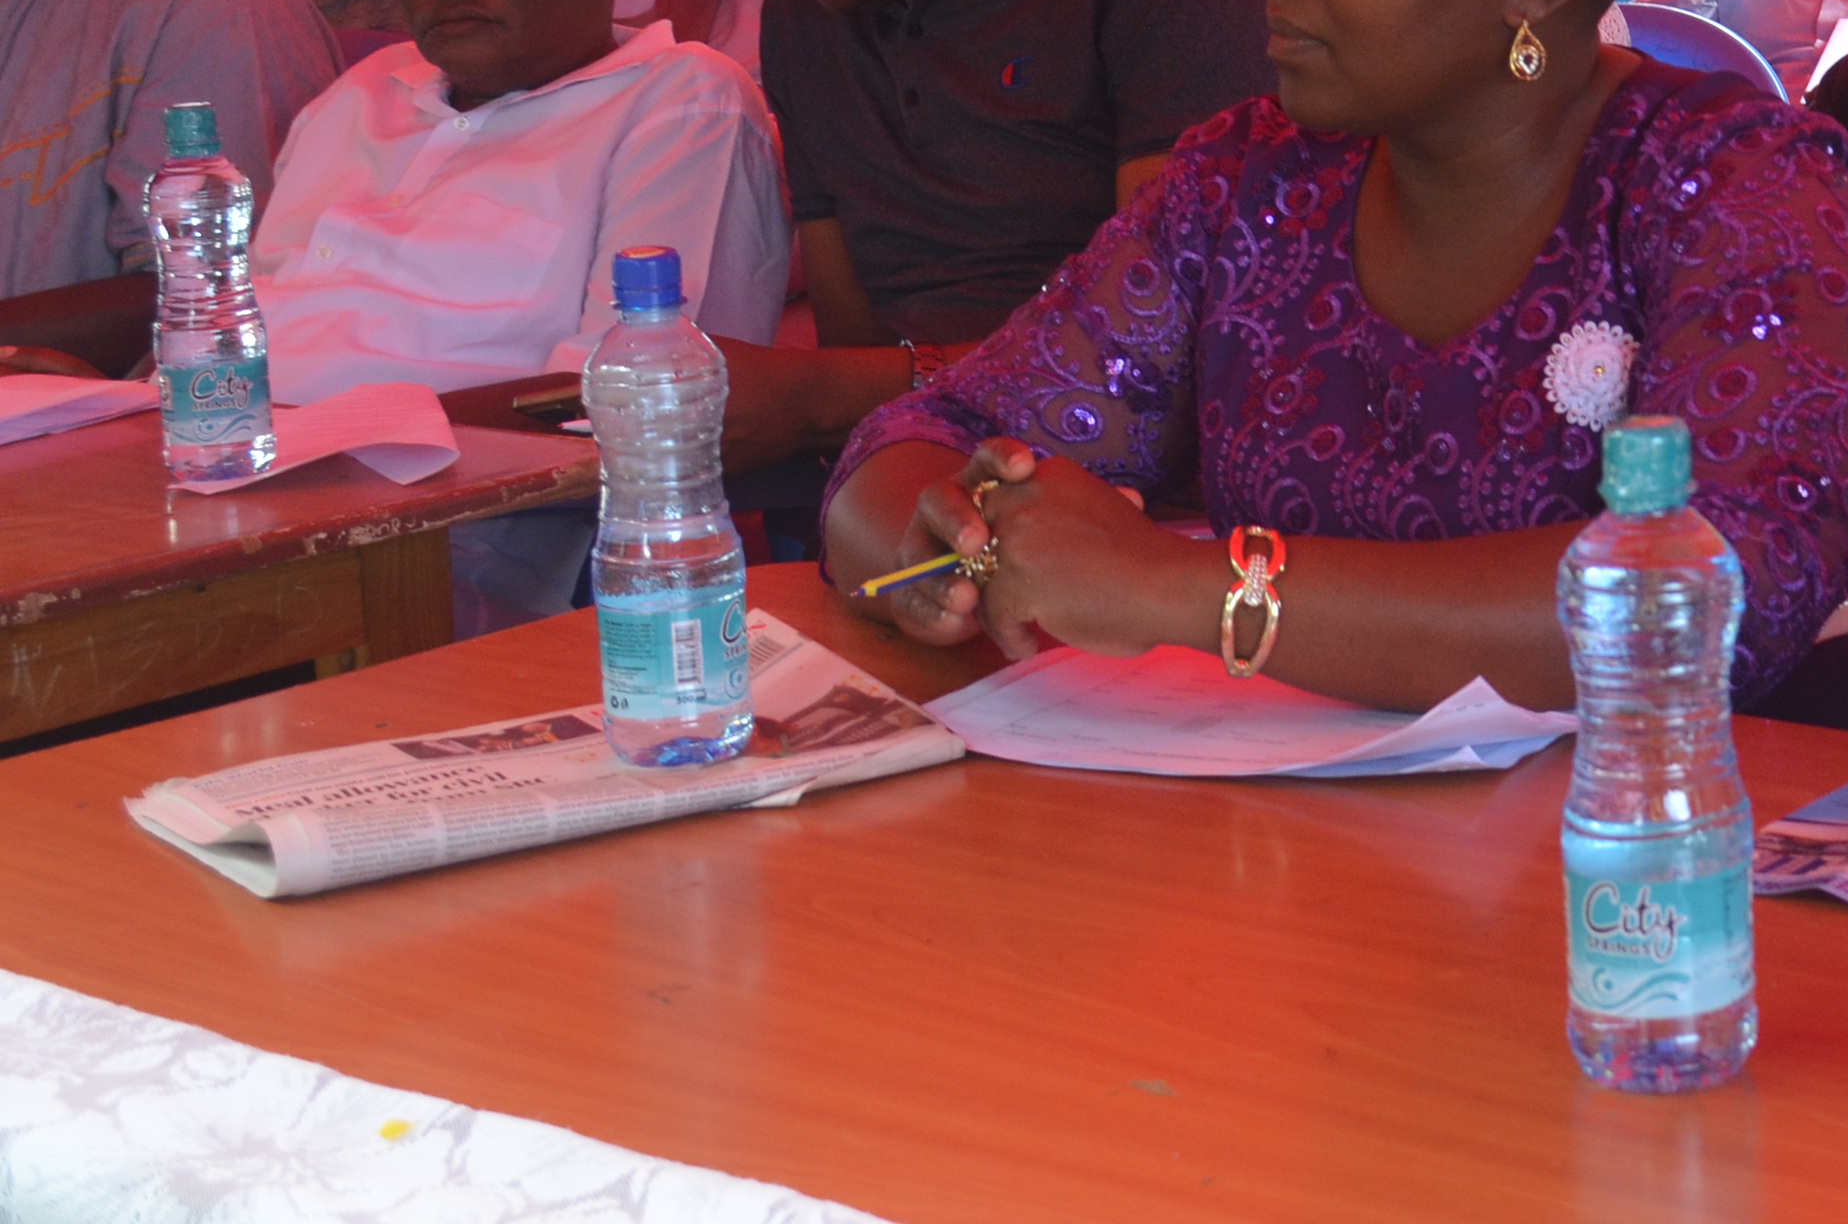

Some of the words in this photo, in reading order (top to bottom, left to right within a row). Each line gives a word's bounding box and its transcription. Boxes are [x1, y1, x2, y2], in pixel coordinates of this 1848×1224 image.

[190, 368, 251, 409] City
[192, 399, 237, 411] SPRINGS
[234, 795, 314, 816] Meal
[323, 766, 484, 802] allowance
[386, 787, 433, 801] for
[442, 771, 507, 791] civil
[1585, 882, 1682, 961] City
[1587, 937, 1652, 956] SPRINGS
